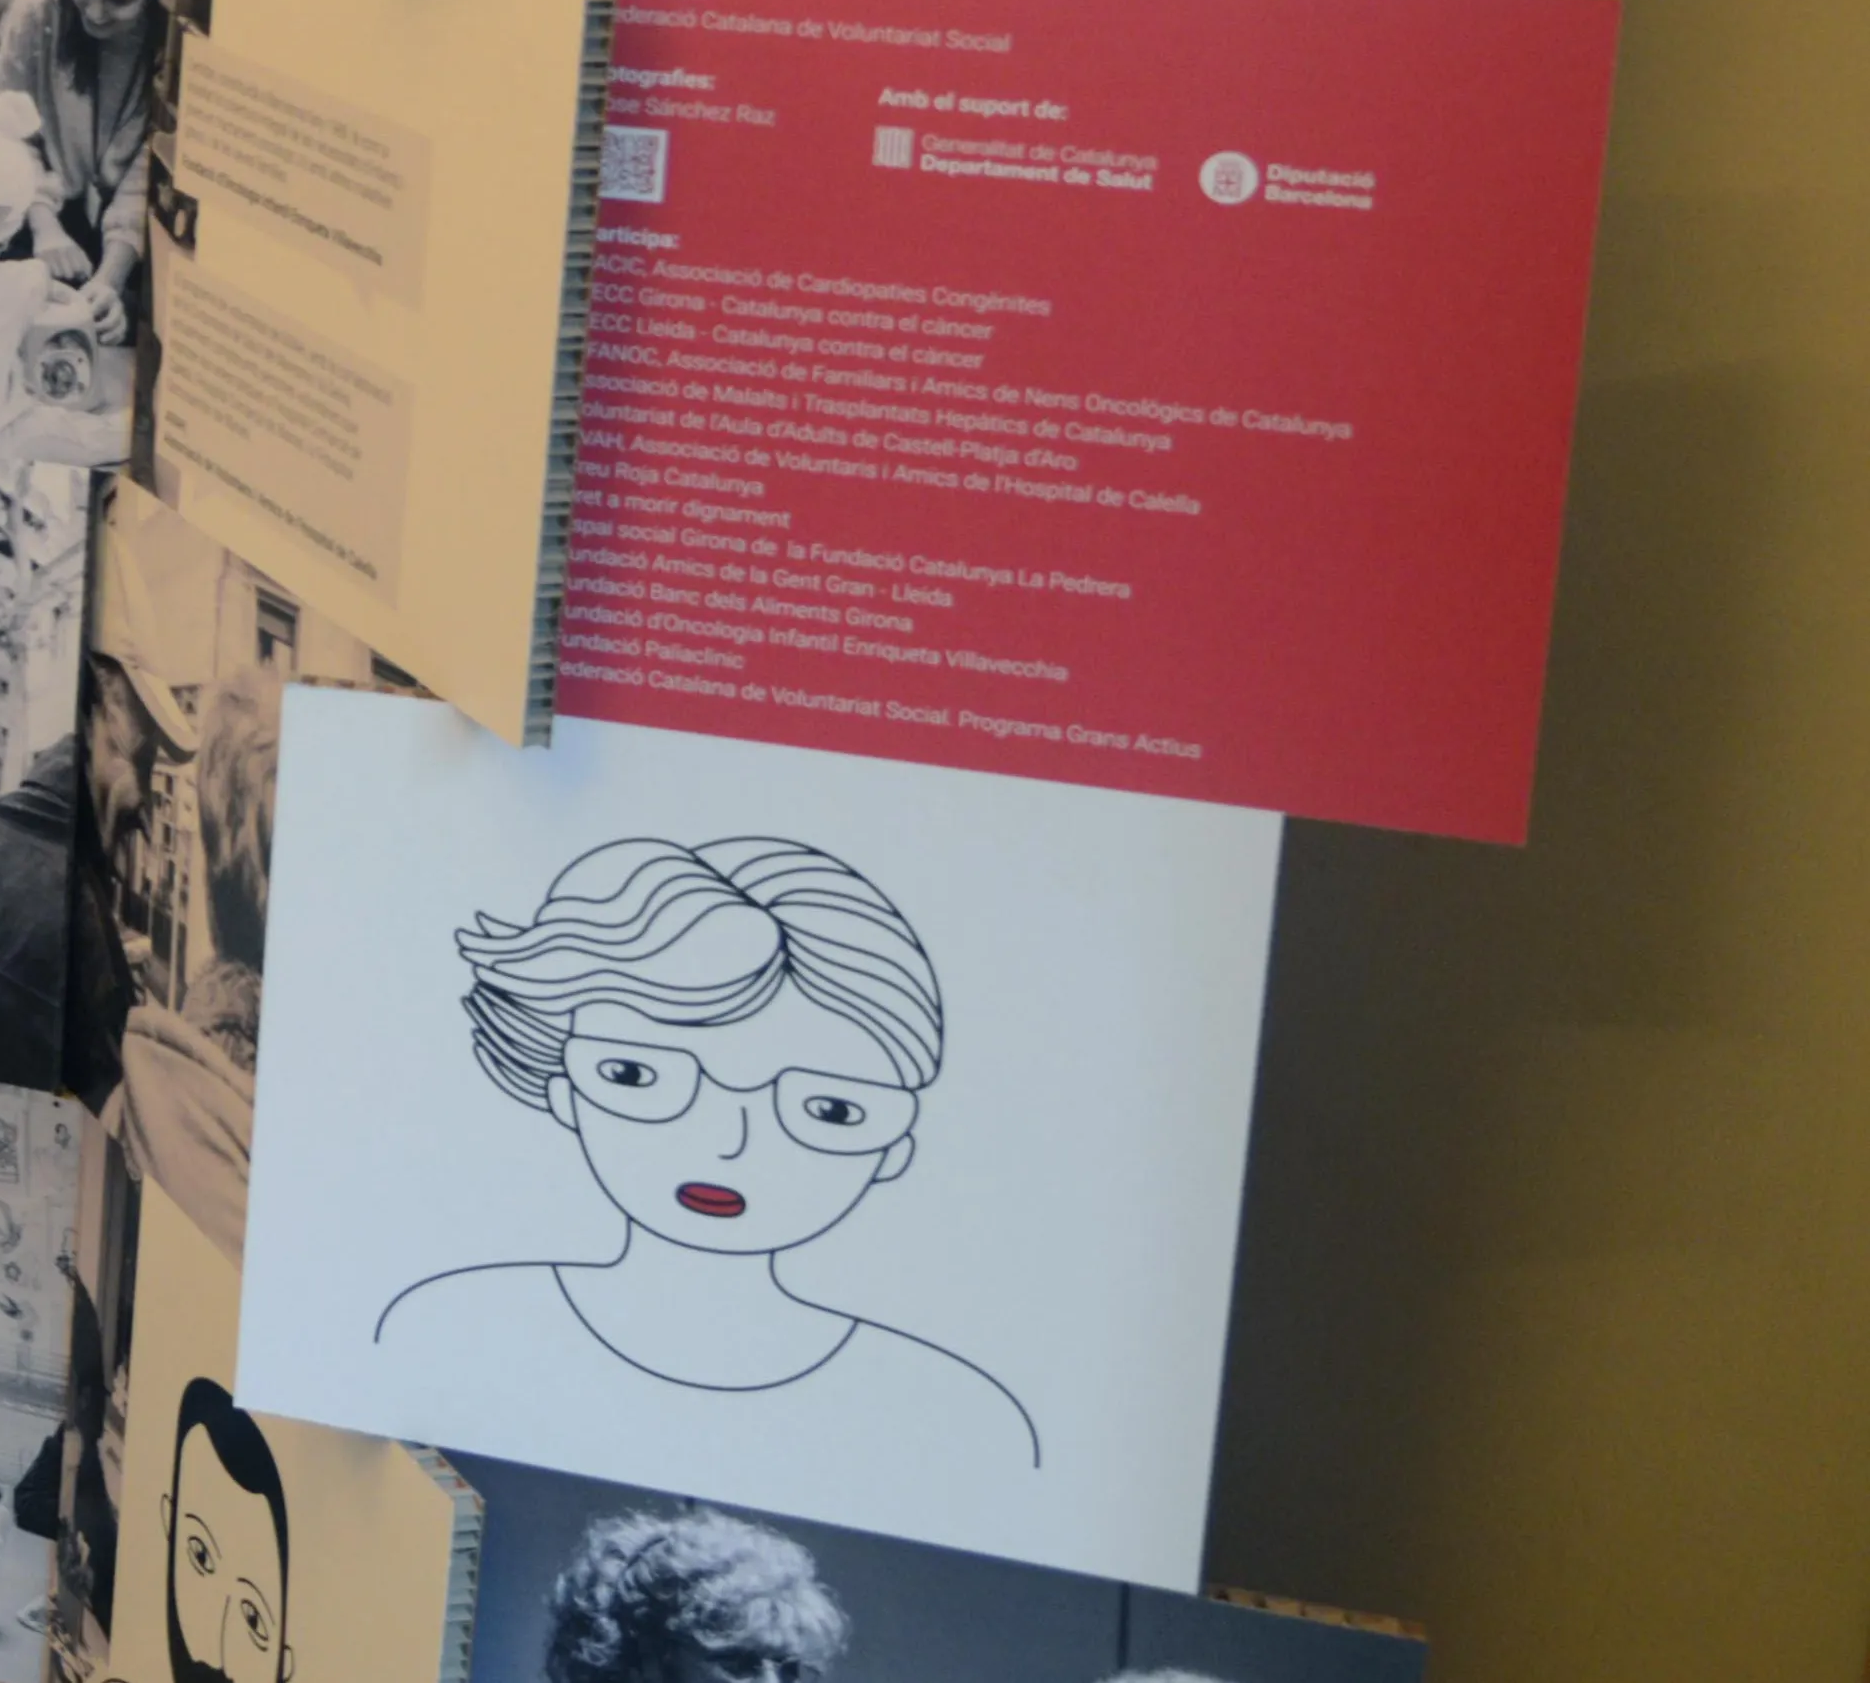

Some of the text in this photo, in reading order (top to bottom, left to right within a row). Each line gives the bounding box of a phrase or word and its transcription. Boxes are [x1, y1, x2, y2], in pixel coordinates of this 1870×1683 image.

[700, 9, 1011, 53] Catalana de Voluntariat Social
[605, 66, 716, 90] otografies:
[735, 103, 776, 126] Raz
[878, 86, 1069, 120] Amb el suport de:
[919, 134, 1158, 172] Generalitat de Catalunya
[919, 155, 1154, 190] Departament de Salut
[1267, 163, 1376, 188] Diputació
[1264, 187, 1373, 209] Barcelona
[595, 226, 681, 250] articipa:
[593, 253, 646, 277] ACIC,
[651, 258, 763, 287] Associació
[765, 270, 794, 290] de
[796, 272, 927, 304] Cardiopaties
[590, 280, 633, 303] ECC
[638, 286, 706, 311] Girona
[720, 294, 824, 325] Catalunya
[826, 309, 896, 331] contra
[897, 314, 919, 332] el
[587, 308, 631, 332] ECC
[635, 316, 697, 340] Lleida
[711, 323, 814, 355] Catalunya
[817, 338, 886, 359] contra
[887, 344, 909, 362] el
[584, 373, 680, 397] ssociació
[681, 380, 709, 401] de
[712, 383, 788, 410] Malalts
[804, 392, 931, 425] Trasplantats
[1032, 418, 1061, 439] de
[1064, 421, 1172, 452] Catalunya
[585, 339, 663, 367] FANOC,
[665, 349, 778, 378] Associació
[779, 361, 808, 381] de
[811, 364, 907, 392] Familiars
[920, 376, 989, 400] Amics
[992, 383, 1021, 404] de
[1023, 386, 1080, 410] Nens
[1208, 406, 1238, 426] de
[1241, 408, 1354, 440] Catalunya
[580, 397, 1079, 471] oluntariat de l'Aula d'Adults de Castell-Platja d'Aro
[577, 425, 1201, 515] VAH, Associació de Voluntaris Amics de l'Hospital de Calella
[578, 460, 764, 498] reu Roja Catalunya
[575, 489, 791, 529] ret a morir dignament
[569, 546, 953, 608] undació Amics de la Gent Gran Lleida
[573, 518, 1132, 599] spai social Girona de la Fundació Catalunya La Pedrera
[568, 576, 914, 633] undació Banc dels Aliments Girona
[562, 633, 642, 656] undació
[564, 604, 1068, 682] undació d'Oncologia Infantil Enriqueta Villavecchia
[559, 660, 645, 686] ederació
[647, 669, 737, 698] Catalana
[739, 682, 767, 702] de
[770, 685, 881, 717] Voluntariat
[958, 709, 1063, 741] Programa
[1065, 723, 1130, 750] Grans
[1133, 733, 1202, 759] Actius
